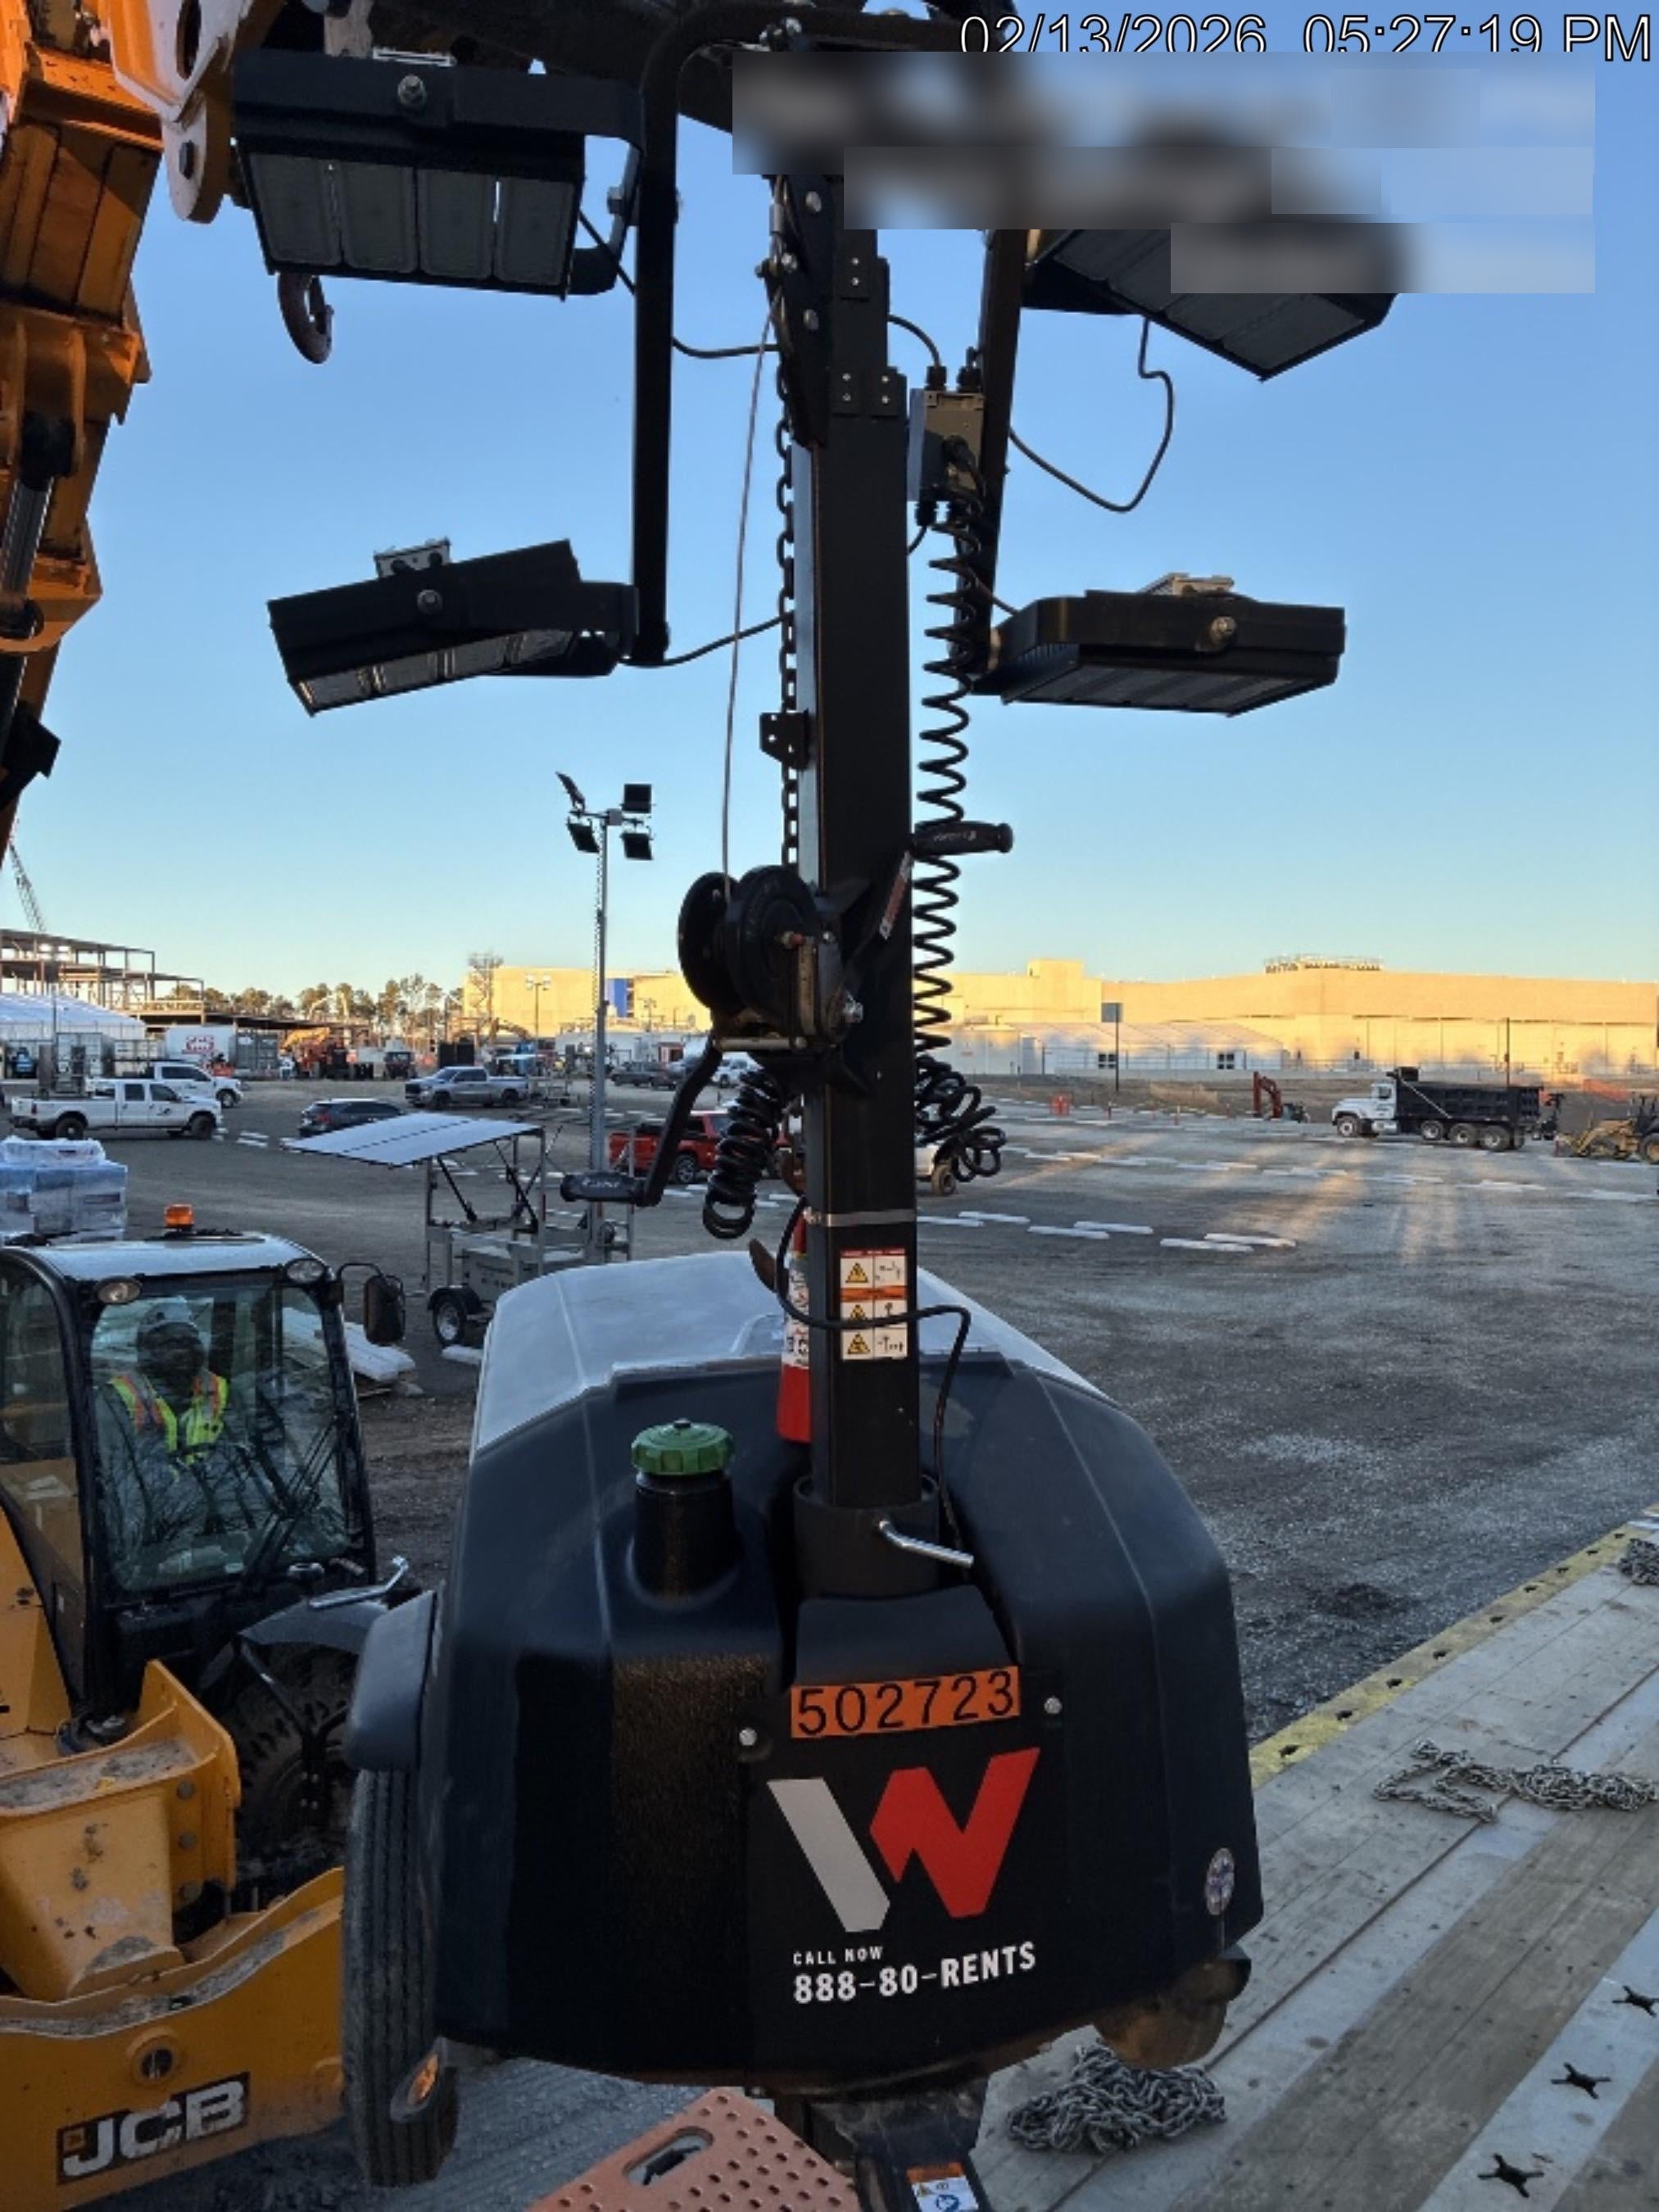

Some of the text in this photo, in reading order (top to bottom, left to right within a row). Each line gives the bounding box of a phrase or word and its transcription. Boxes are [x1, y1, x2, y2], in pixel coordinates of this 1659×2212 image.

[798, 1670, 1014, 1735] 502723
[793, 1945, 884, 1965] CALL NOW
[793, 1941, 1036, 2004] 888-80-RENTS
[62, 2080, 244, 2176] JCB
